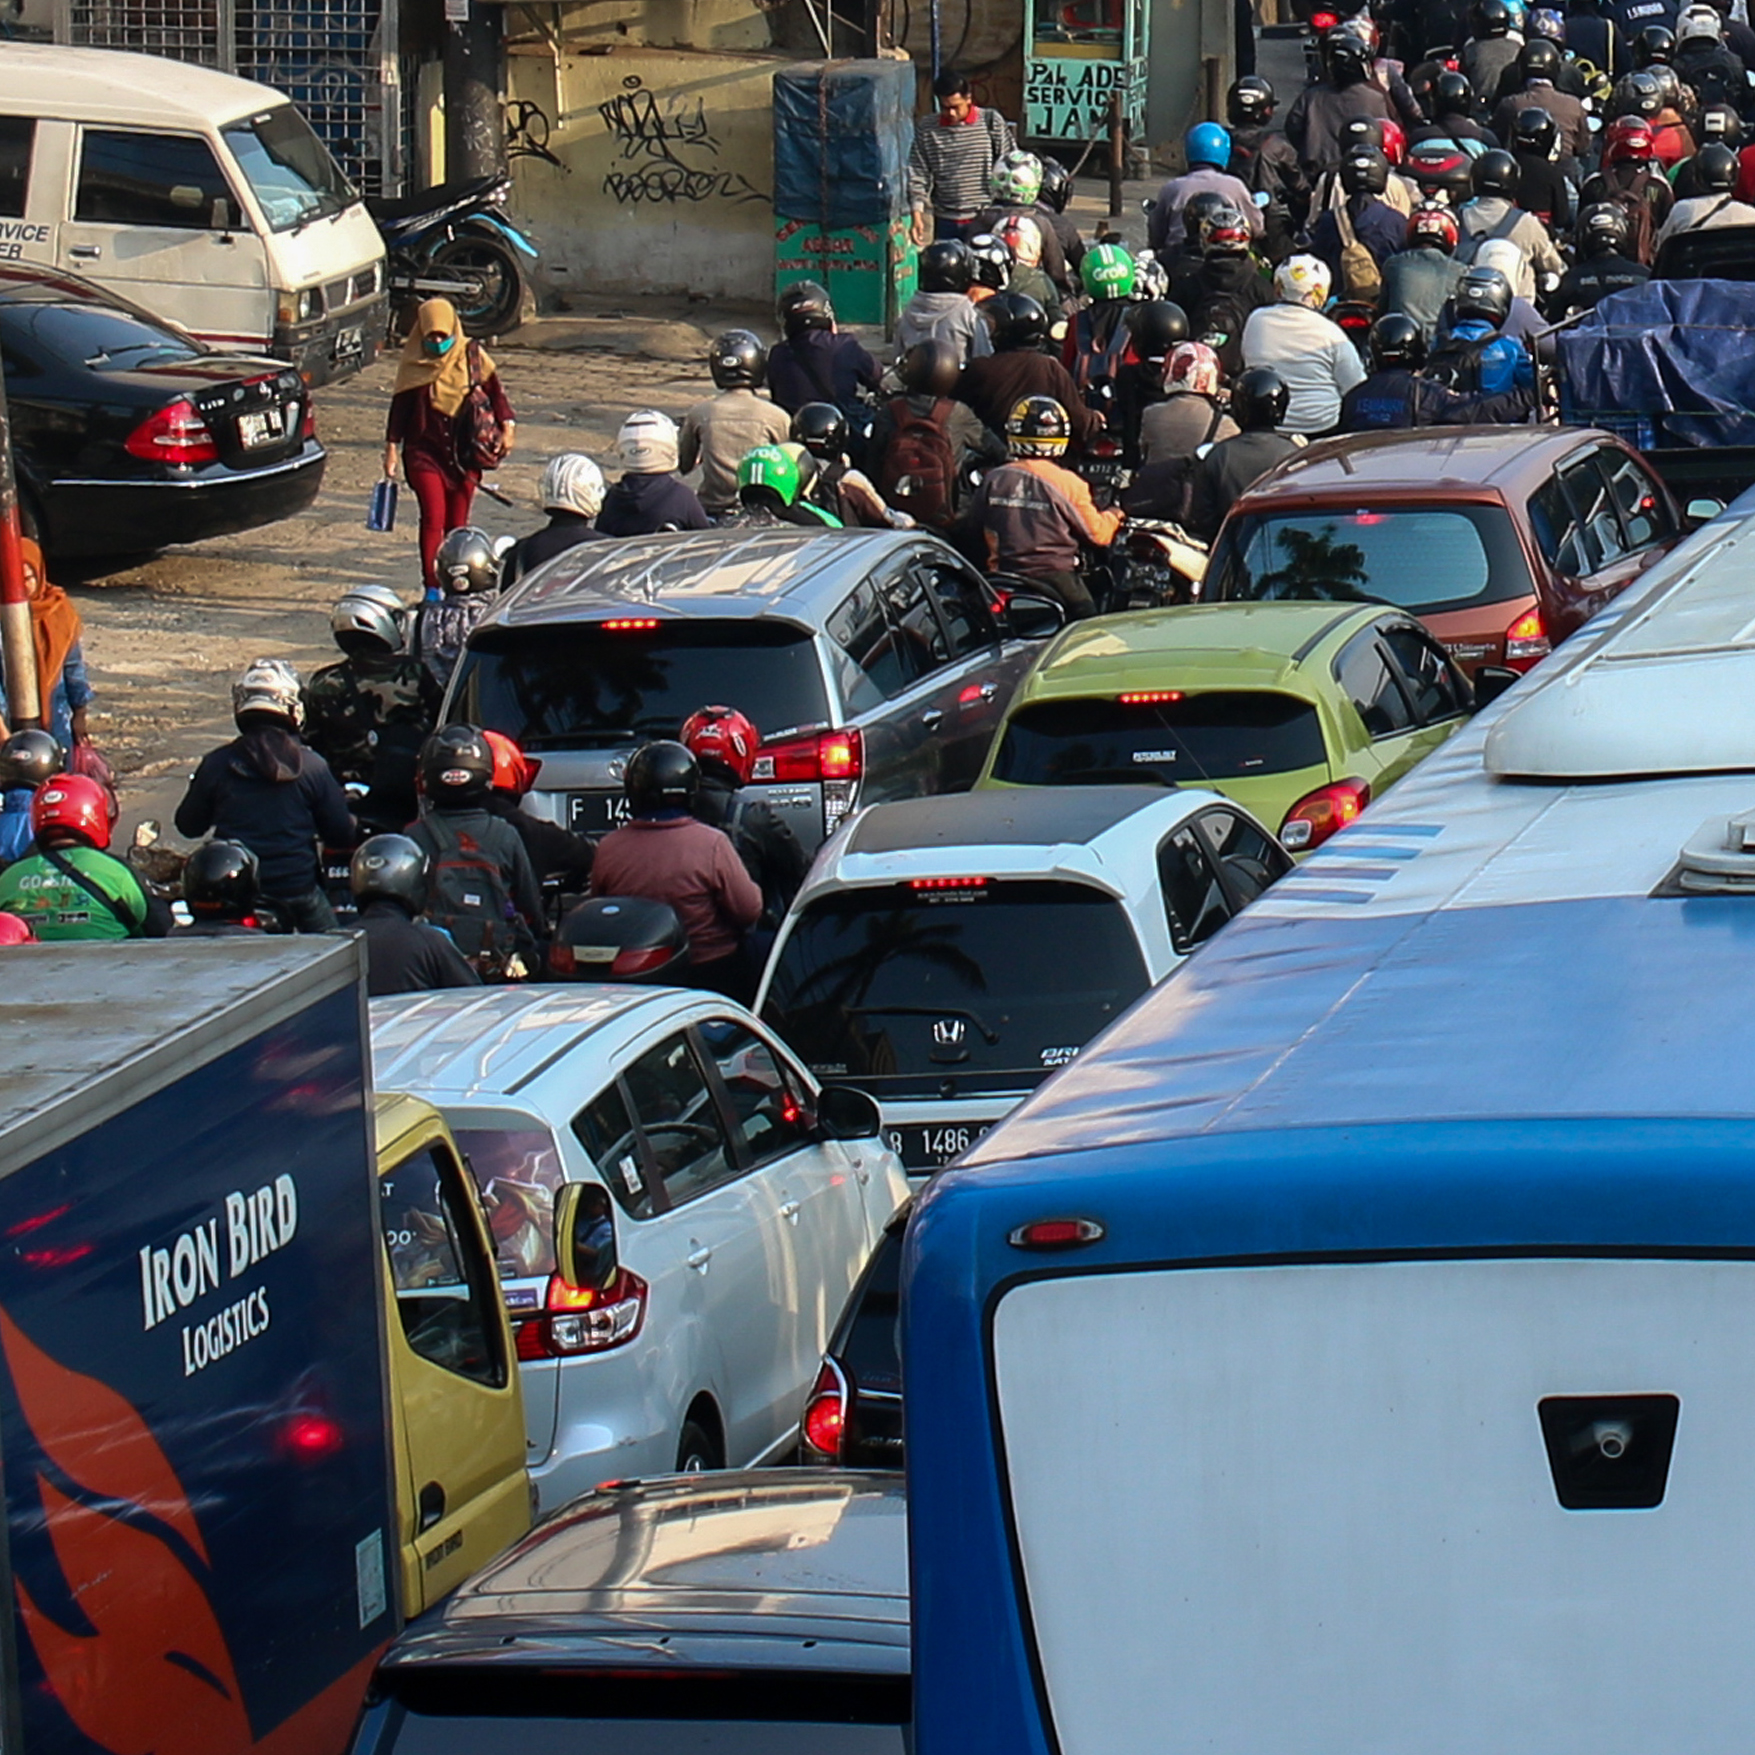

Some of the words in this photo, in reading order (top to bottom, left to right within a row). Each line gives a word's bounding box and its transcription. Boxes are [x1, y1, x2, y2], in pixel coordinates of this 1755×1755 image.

[1076, 65, 1127, 89] ADE
[1092, 262, 1130, 282] Grab
[571, 798, 584, 820] F
[921, 1128, 970, 1155] 1486
[140, 1218, 219, 1331] IRON
[226, 1173, 298, 1279] BIRD
[182, 1285, 270, 1377] LOGISTICS
